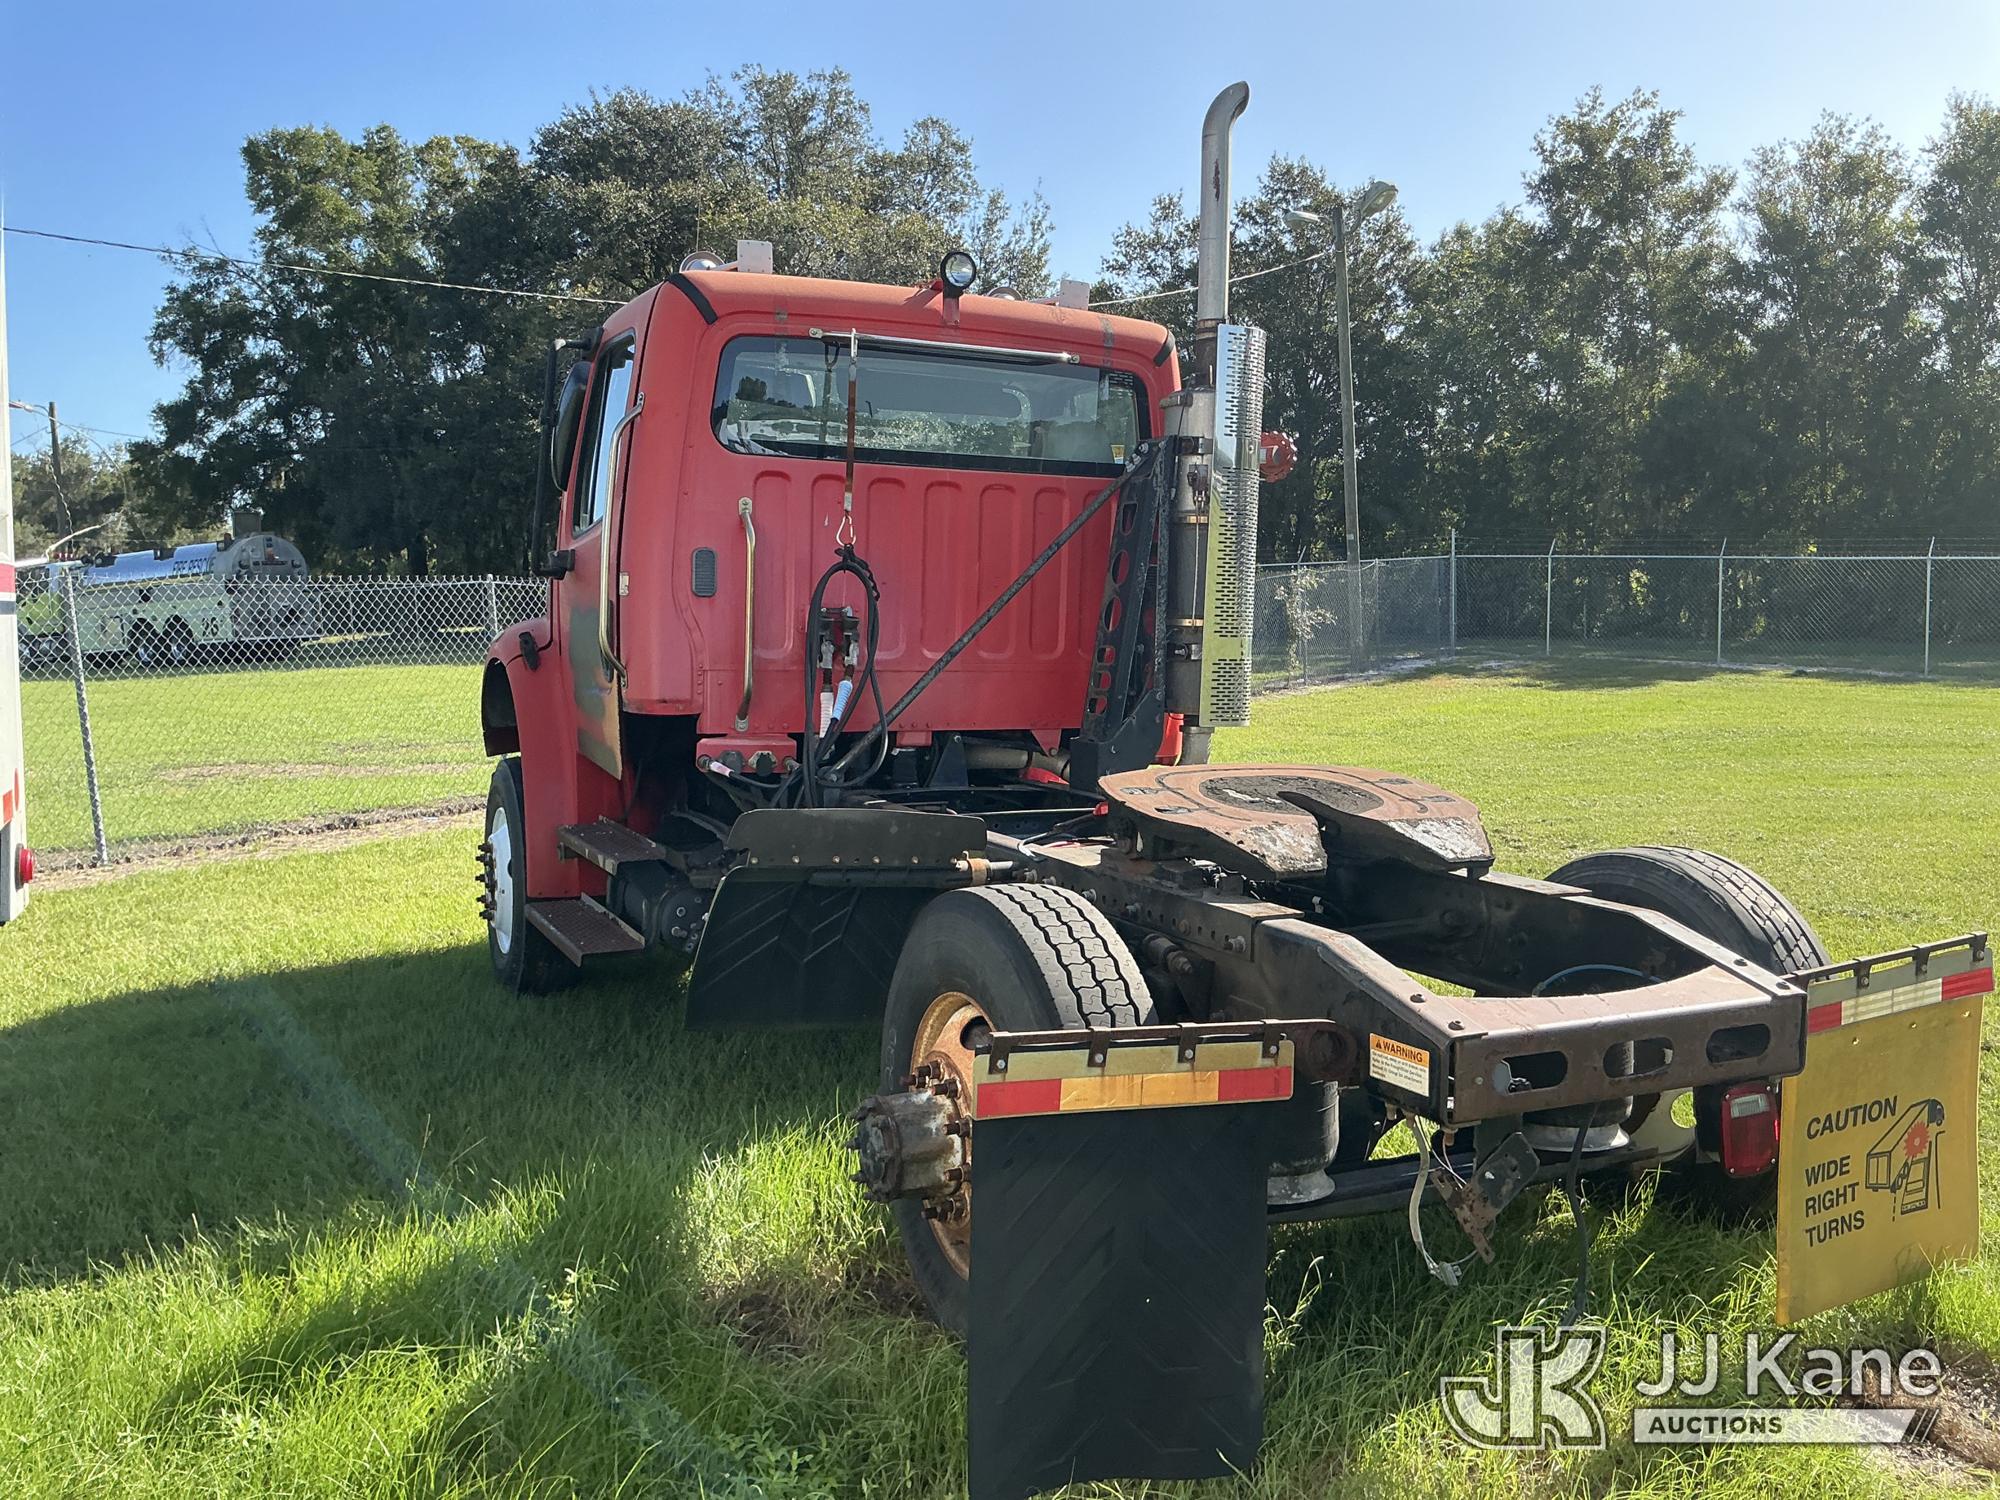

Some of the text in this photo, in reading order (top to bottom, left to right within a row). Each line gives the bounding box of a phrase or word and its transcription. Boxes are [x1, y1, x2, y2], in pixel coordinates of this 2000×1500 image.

[1383, 1041, 1423, 1062] WARNING
[1806, 1095, 1898, 1140] CAUTION
[1805, 1155, 1852, 1187] WIDE
[1805, 1182, 1860, 1218] RIGHT
[1805, 1210, 1865, 1248] TURNS
